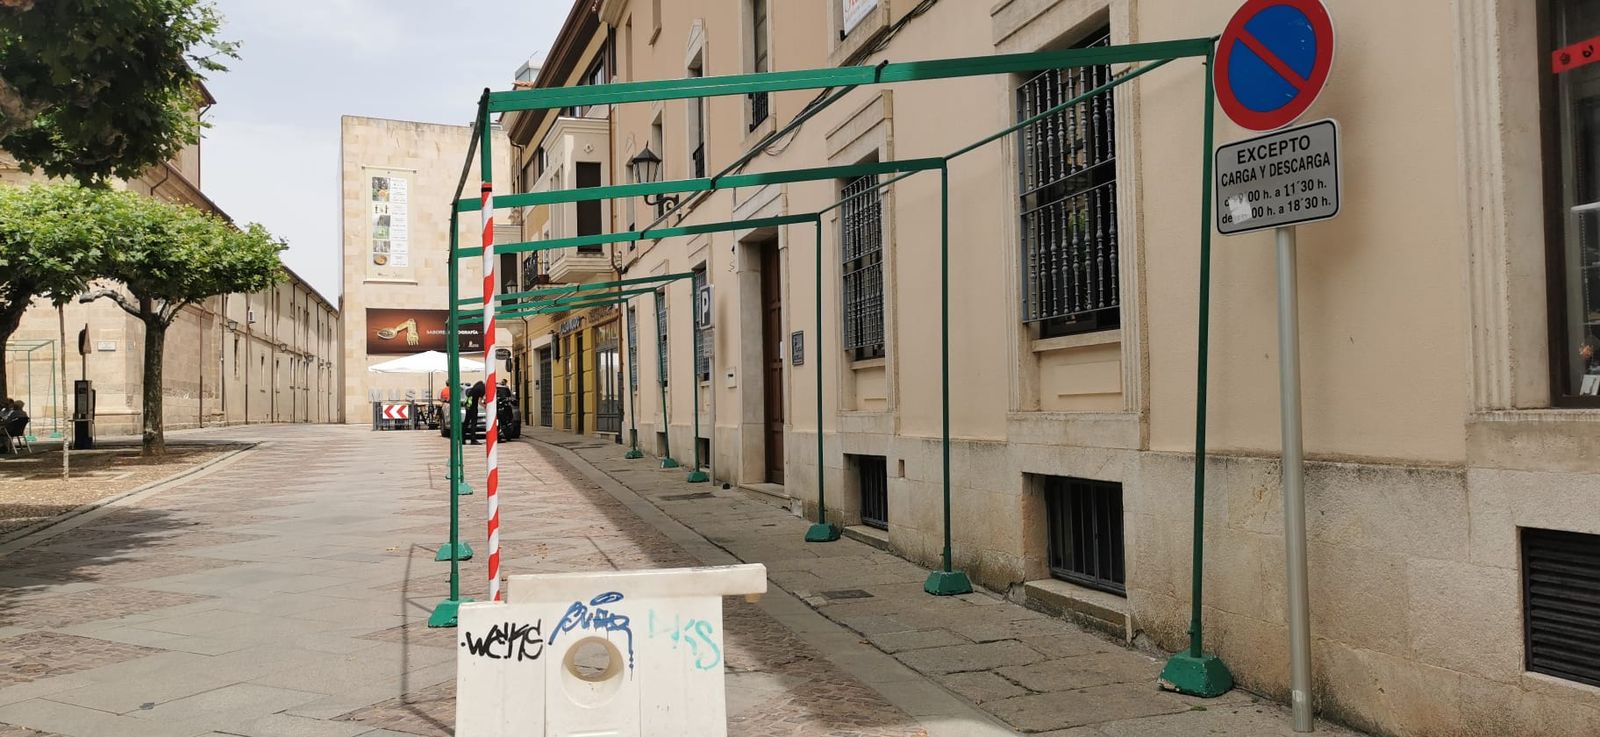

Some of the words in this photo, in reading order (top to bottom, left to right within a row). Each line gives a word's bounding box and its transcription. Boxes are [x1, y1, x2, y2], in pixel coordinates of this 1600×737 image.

[1237, 135, 1310, 164] EXCEPTO
[1221, 168, 1257, 187] CARGA
[1259, 165, 1266, 179] Y
[1269, 152, 1331, 177] DESCARGA
[1263, 189, 1272, 199] h.
[1275, 188, 1281, 198] a
[1317, 179, 1327, 189] h.
[1222, 213, 1233, 224] de
[1266, 206, 1276, 216] h.
[1278, 206, 1284, 214] a
[1321, 196, 1332, 207] h.
[701, 290, 709, 325] P
